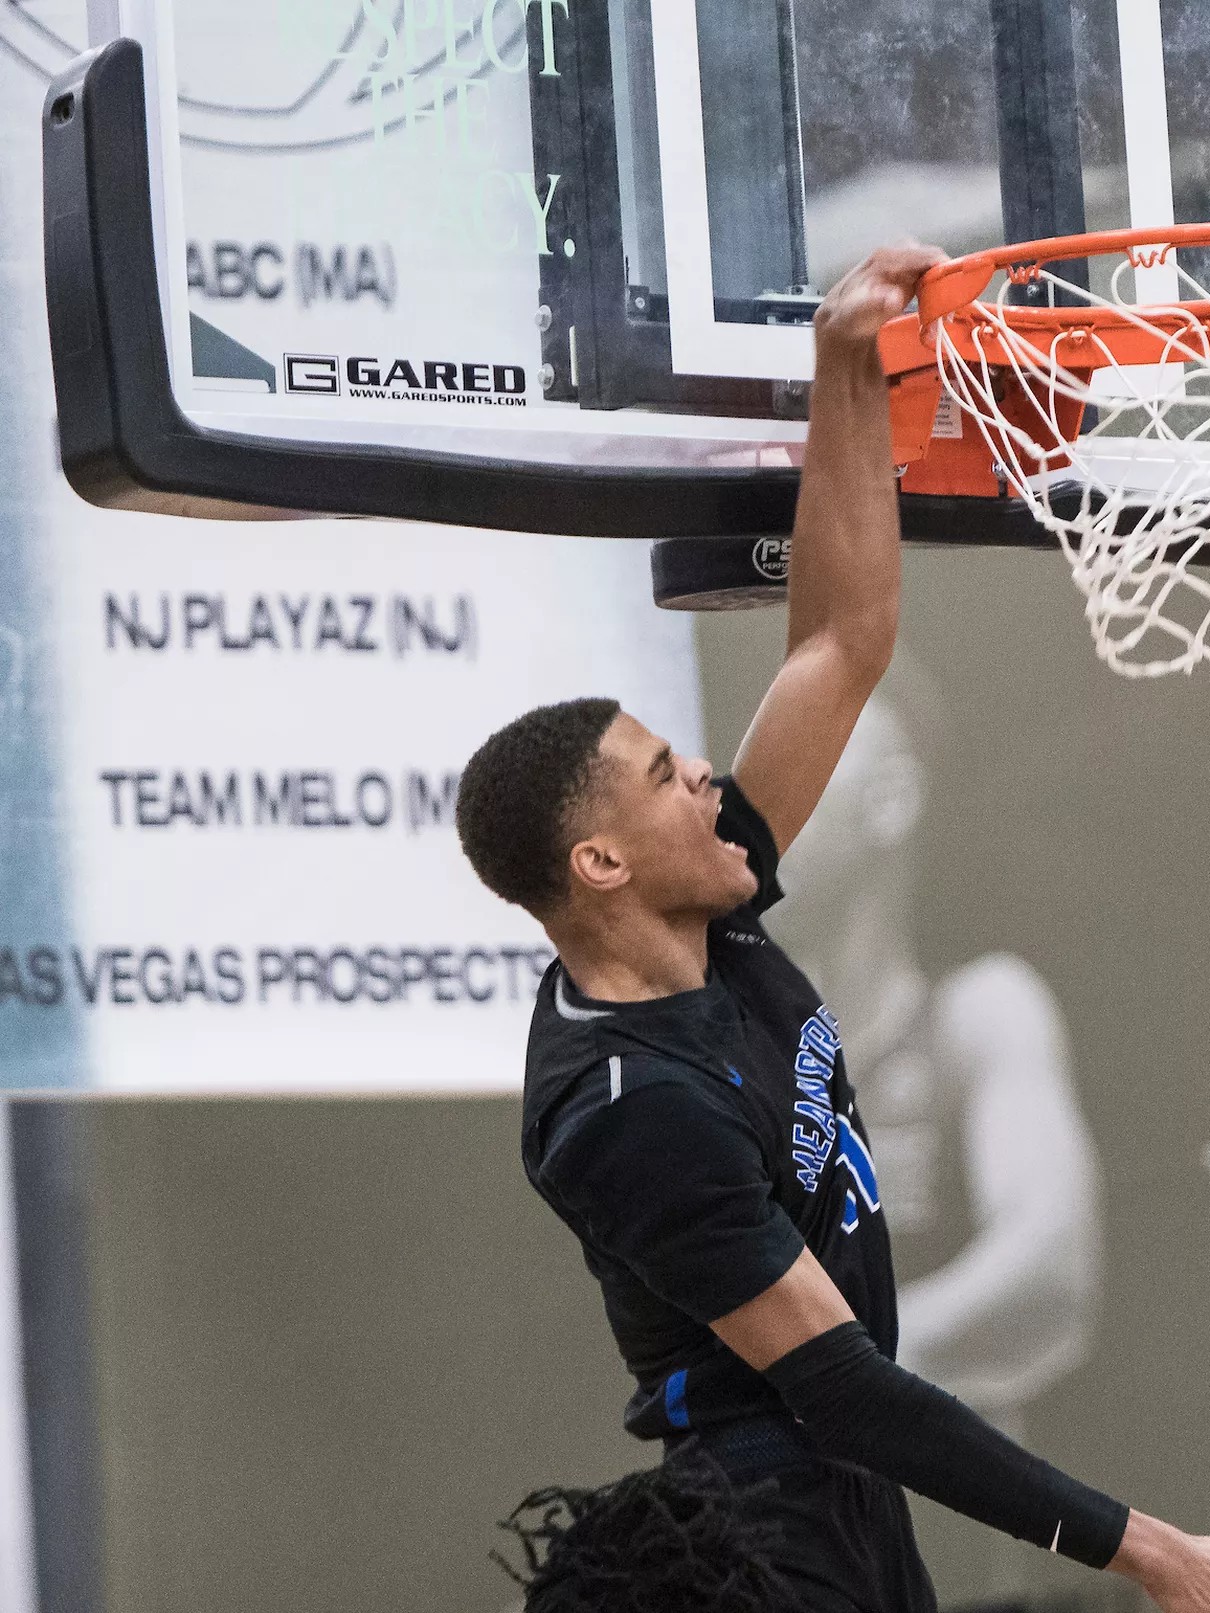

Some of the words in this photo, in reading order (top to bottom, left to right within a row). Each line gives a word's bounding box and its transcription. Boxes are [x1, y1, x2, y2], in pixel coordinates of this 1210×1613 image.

[346, 356, 527, 394] GARED
[349, 388, 528, 407] WWW.GAREDSPORTS.COM
[103, 592, 170, 653] NJ
[182, 593, 379, 655] PLAYAZ
[100, 770, 241, 829] TEAM
[252, 768, 394, 829] MELO
[70, 945, 246, 1005] VEGAS
